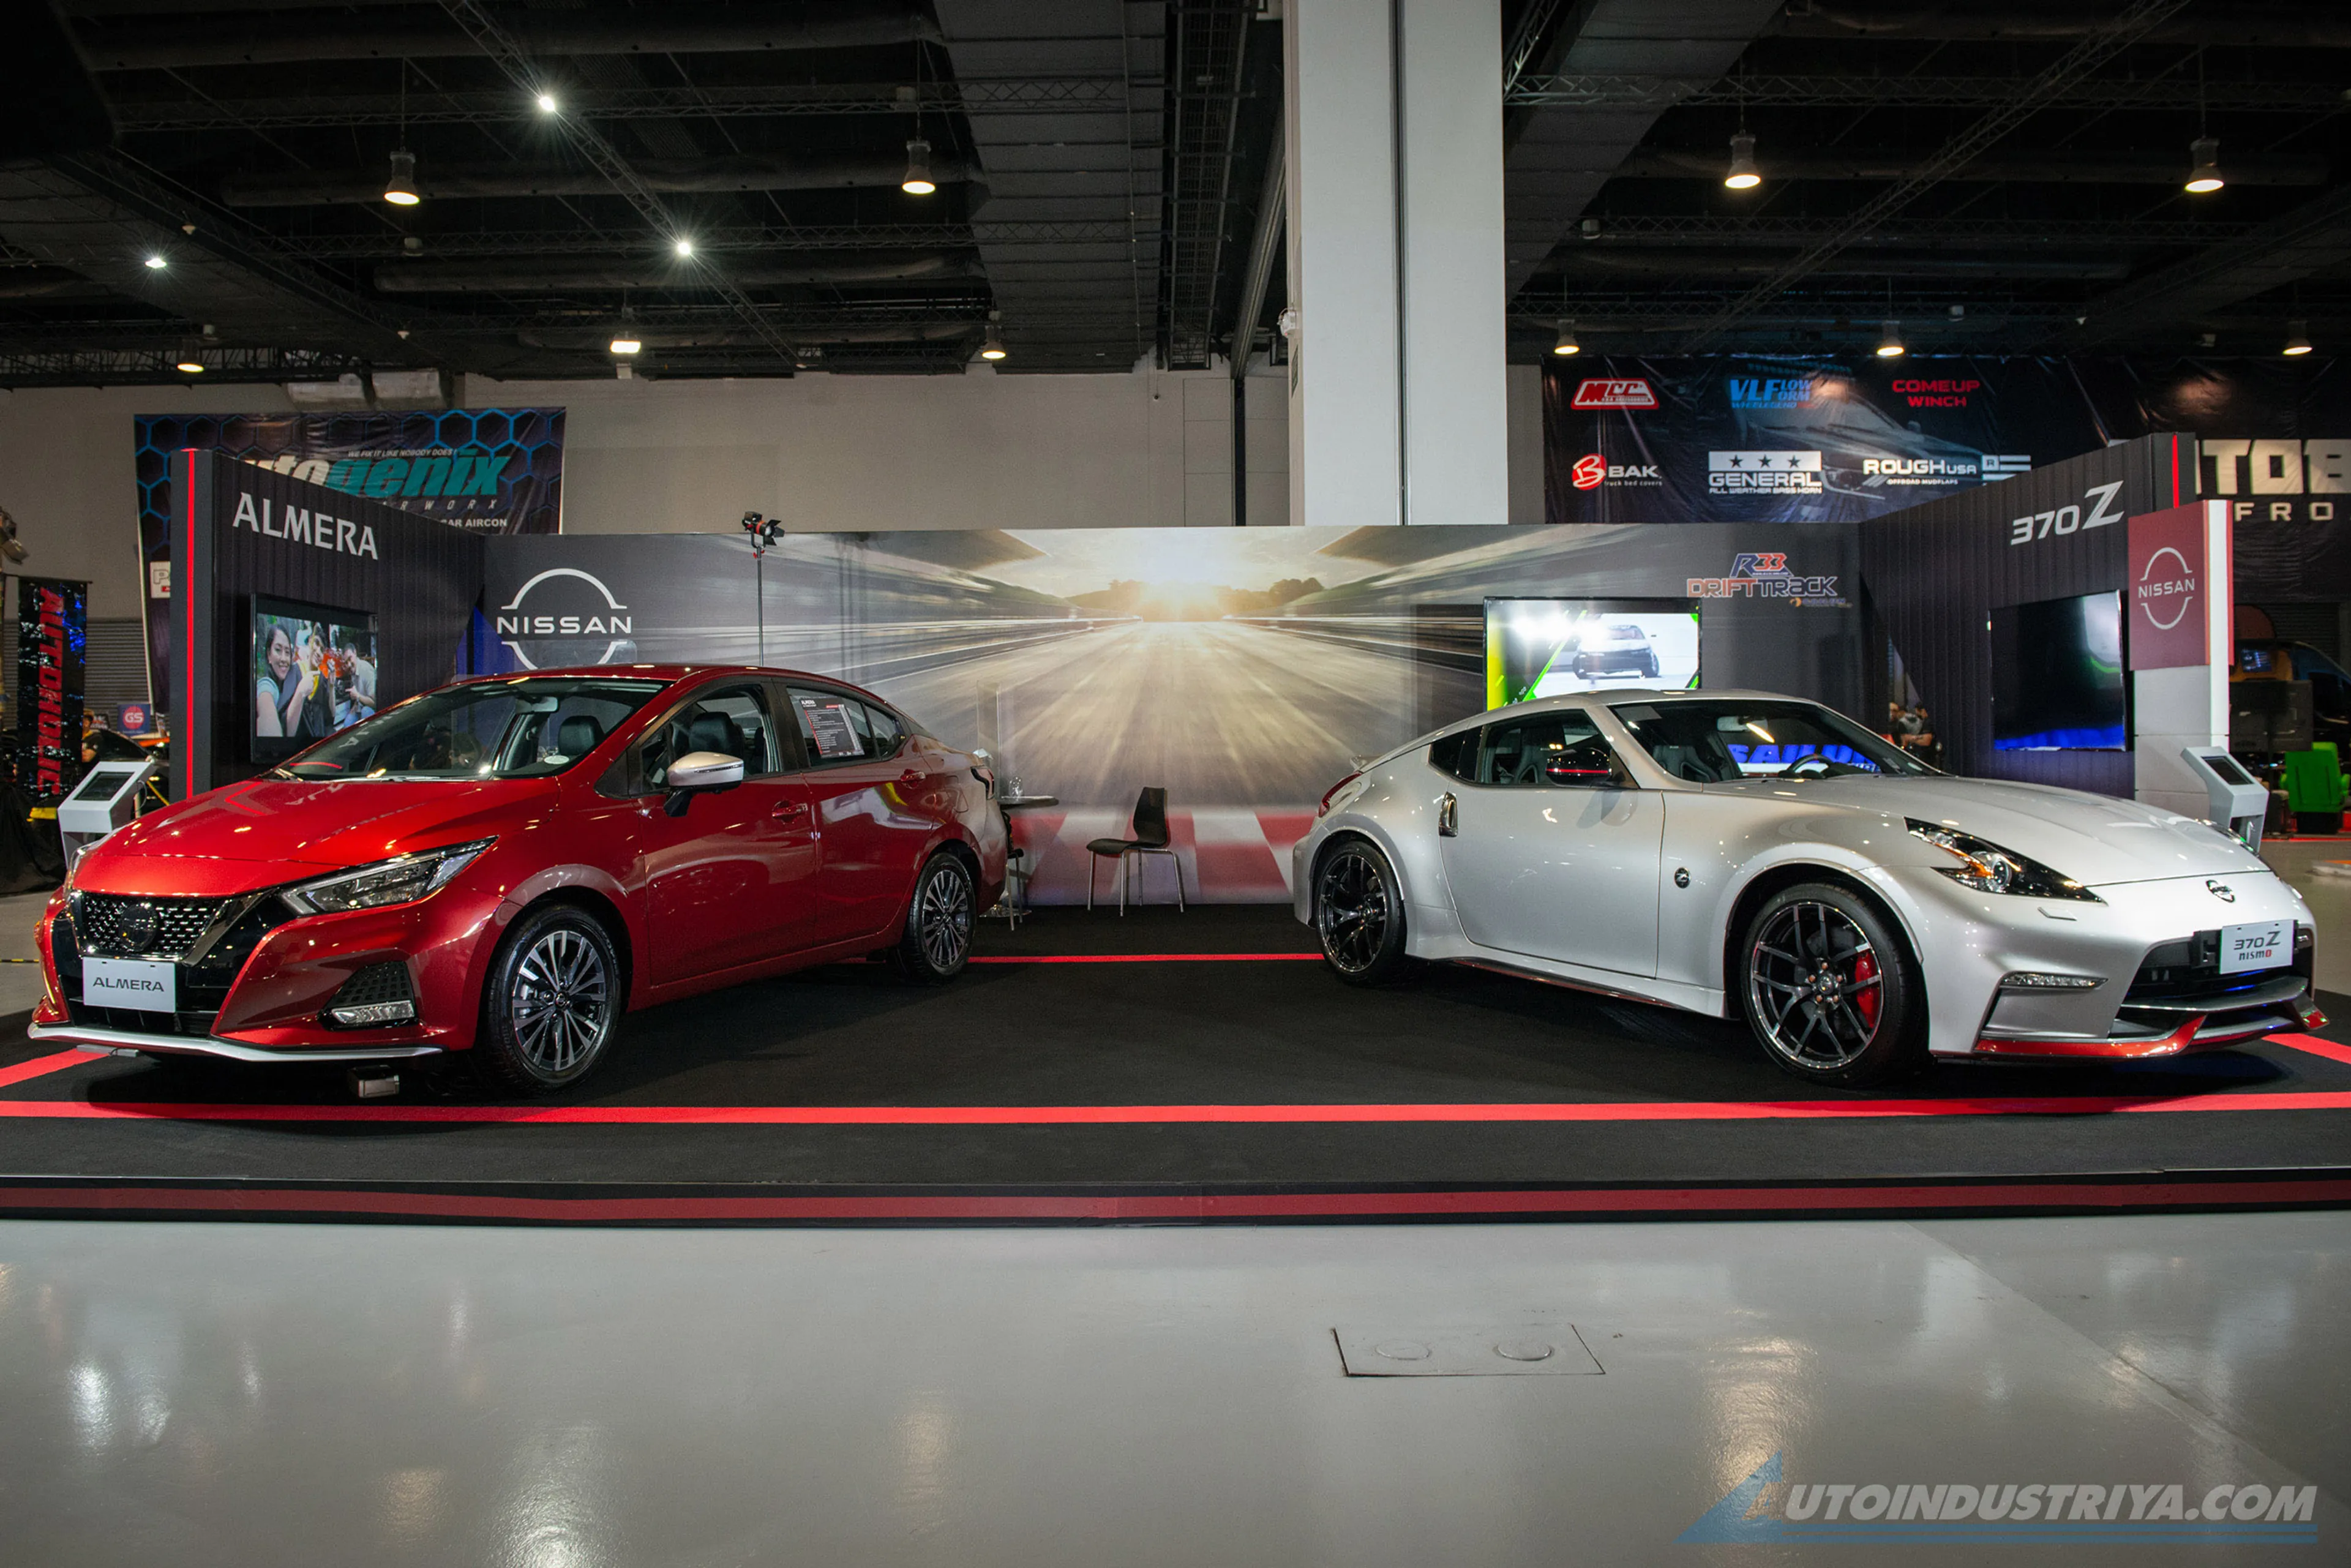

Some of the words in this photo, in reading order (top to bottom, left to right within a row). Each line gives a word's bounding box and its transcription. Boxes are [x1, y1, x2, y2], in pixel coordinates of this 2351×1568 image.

[1892, 380, 1981, 392] COMEUP
[1907, 396, 1967, 407] WINCH
[1608, 465, 1659, 478] BAK
[1863, 459, 1946, 475] ROUGH
[1946, 464, 1977, 475] USA
[2194, 439, 2351, 495] TOB
[1709, 472, 1822, 487] GENERAL
[2011, 480, 2124, 546] 370Z
[2235, 502, 2351, 522] FRO
[232, 492, 378, 560] ALMERA
[465, 519, 508, 527] AIRCON
[2137, 578, 2195, 598] NISSAN
[497, 617, 632, 634] NISSAN
[37, 587, 64, 795] AUTOHOLIC
[124, 712, 144, 723] GS
[2233, 930, 2281, 950] 370Z
[92, 977, 165, 992] ALMERA
